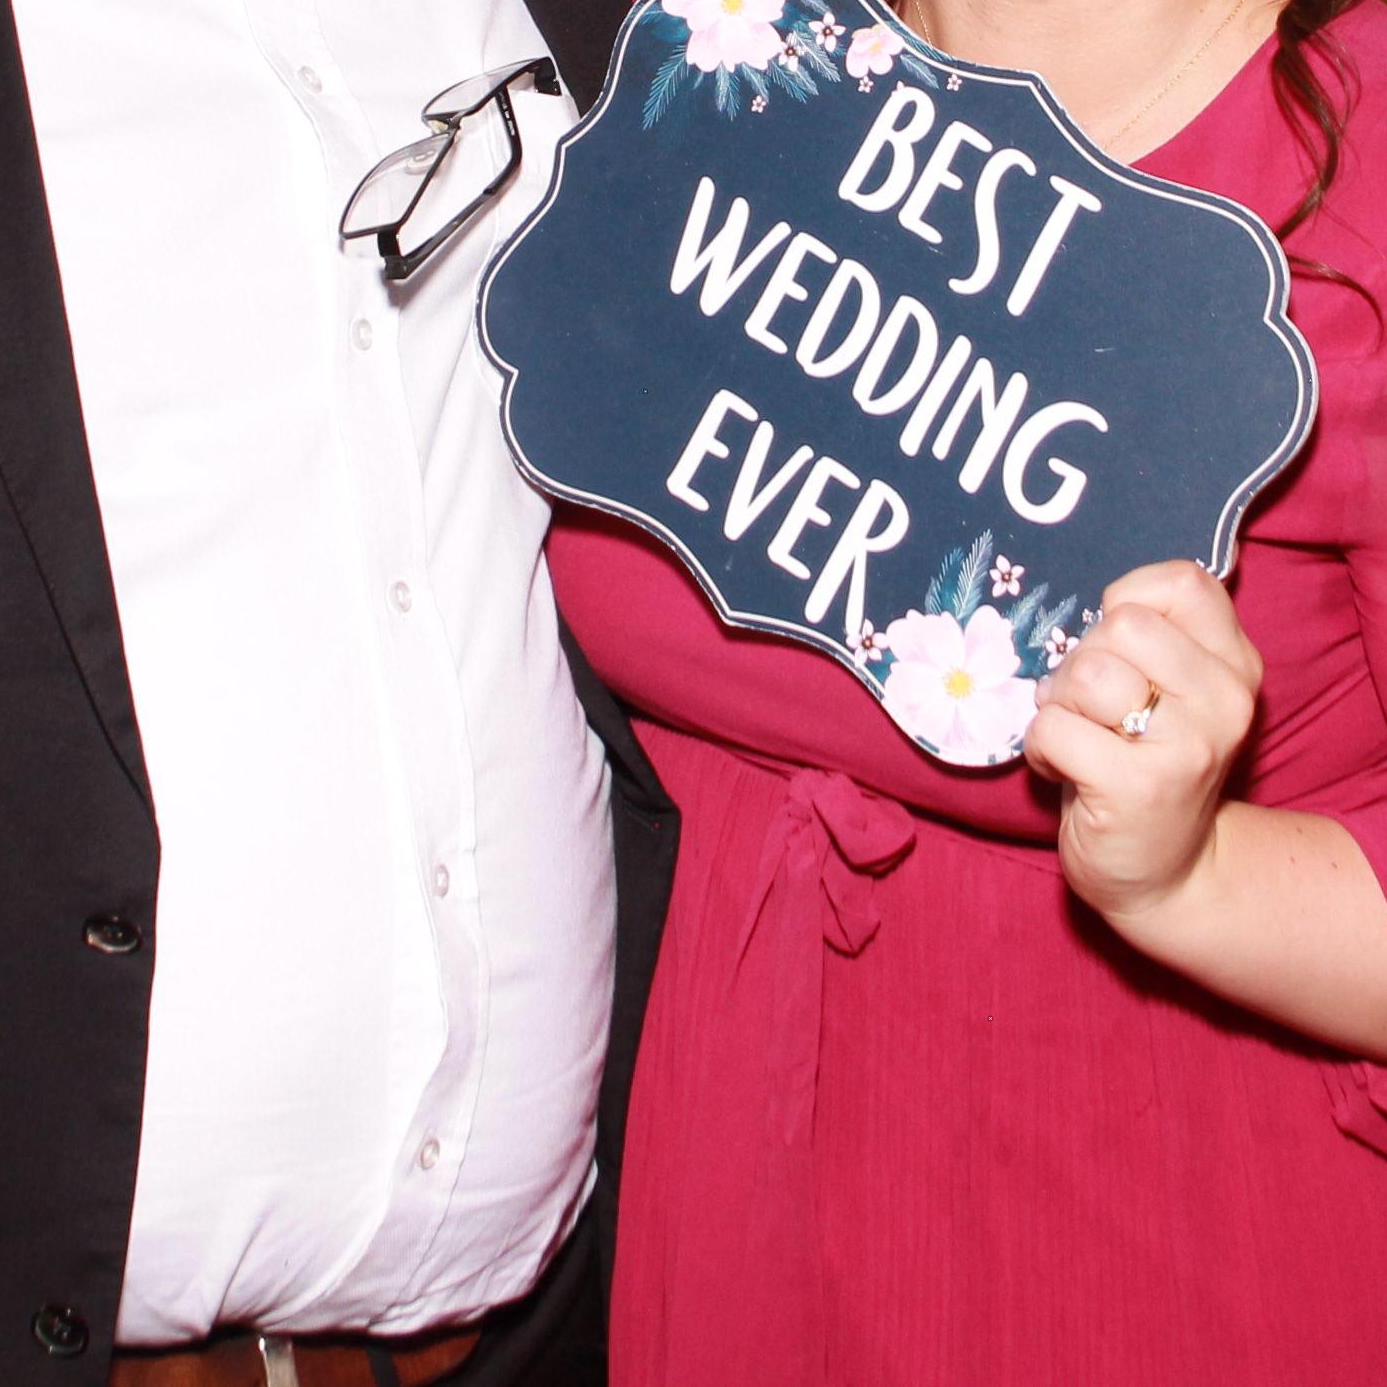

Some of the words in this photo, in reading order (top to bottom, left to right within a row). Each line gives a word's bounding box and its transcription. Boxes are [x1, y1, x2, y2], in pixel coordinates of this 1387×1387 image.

[838, 86, 1103, 317] BEST
[669, 176, 1109, 525] WEDDING
[666, 389, 910, 637] EVER
